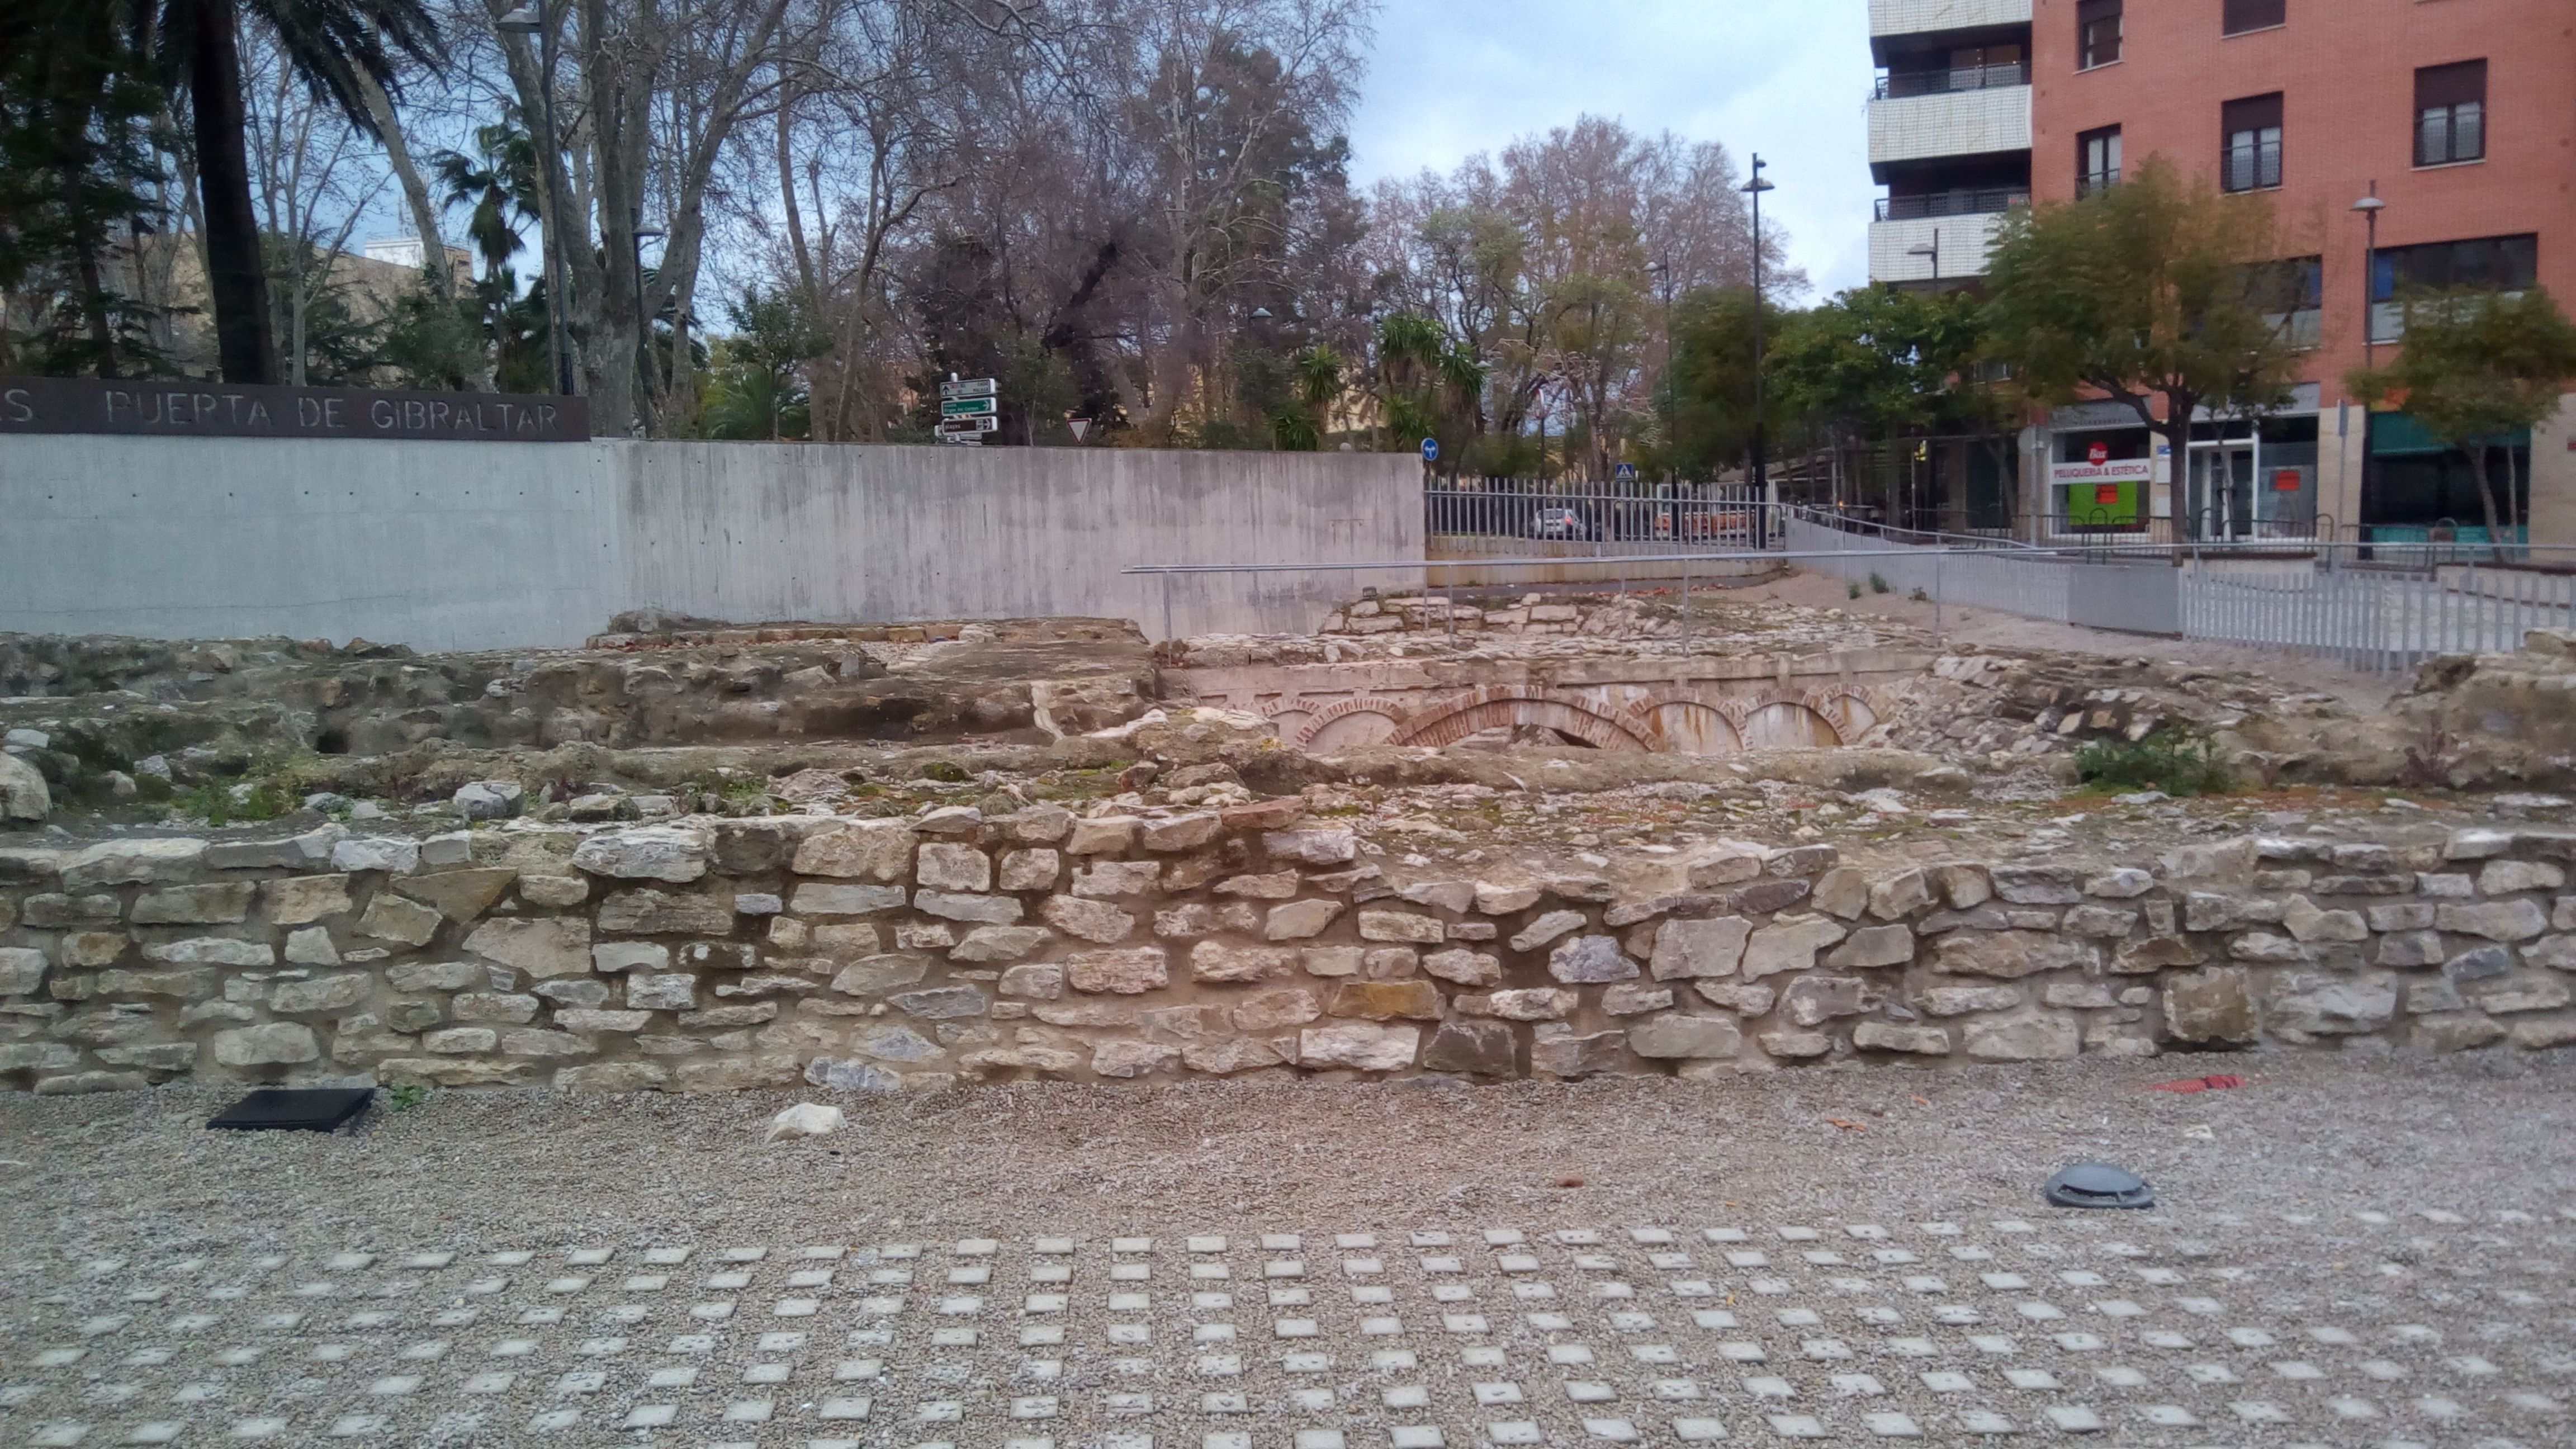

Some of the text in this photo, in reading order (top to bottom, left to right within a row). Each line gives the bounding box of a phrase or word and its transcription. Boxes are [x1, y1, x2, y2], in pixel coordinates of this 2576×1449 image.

[106, 390, 272, 426] PUERTA
[298, 396, 346, 428] DE
[371, 399, 557, 432] GIBRALTAR
